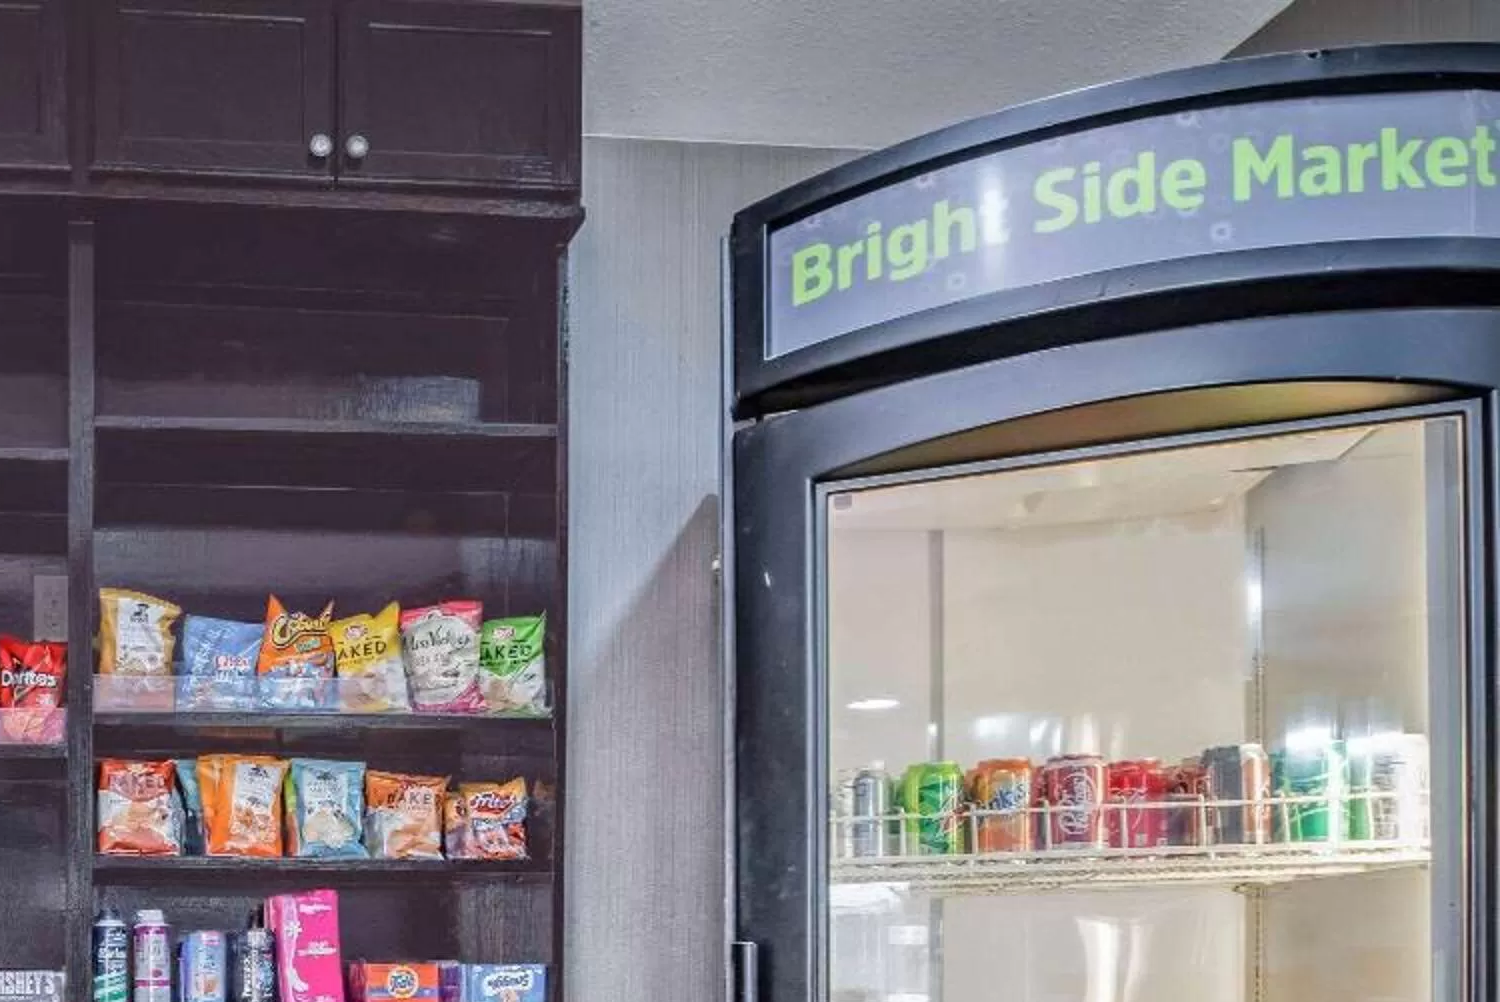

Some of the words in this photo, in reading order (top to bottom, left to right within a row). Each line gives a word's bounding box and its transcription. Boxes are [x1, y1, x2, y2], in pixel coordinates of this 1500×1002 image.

[790, 188, 1008, 308] Bright
[1033, 150, 1204, 234] Side
[1231, 126, 1496, 202] Market
[336, 640, 388, 660] AKED
[479, 643, 534, 660] AKED
[1, 668, 57, 689] Doritos
